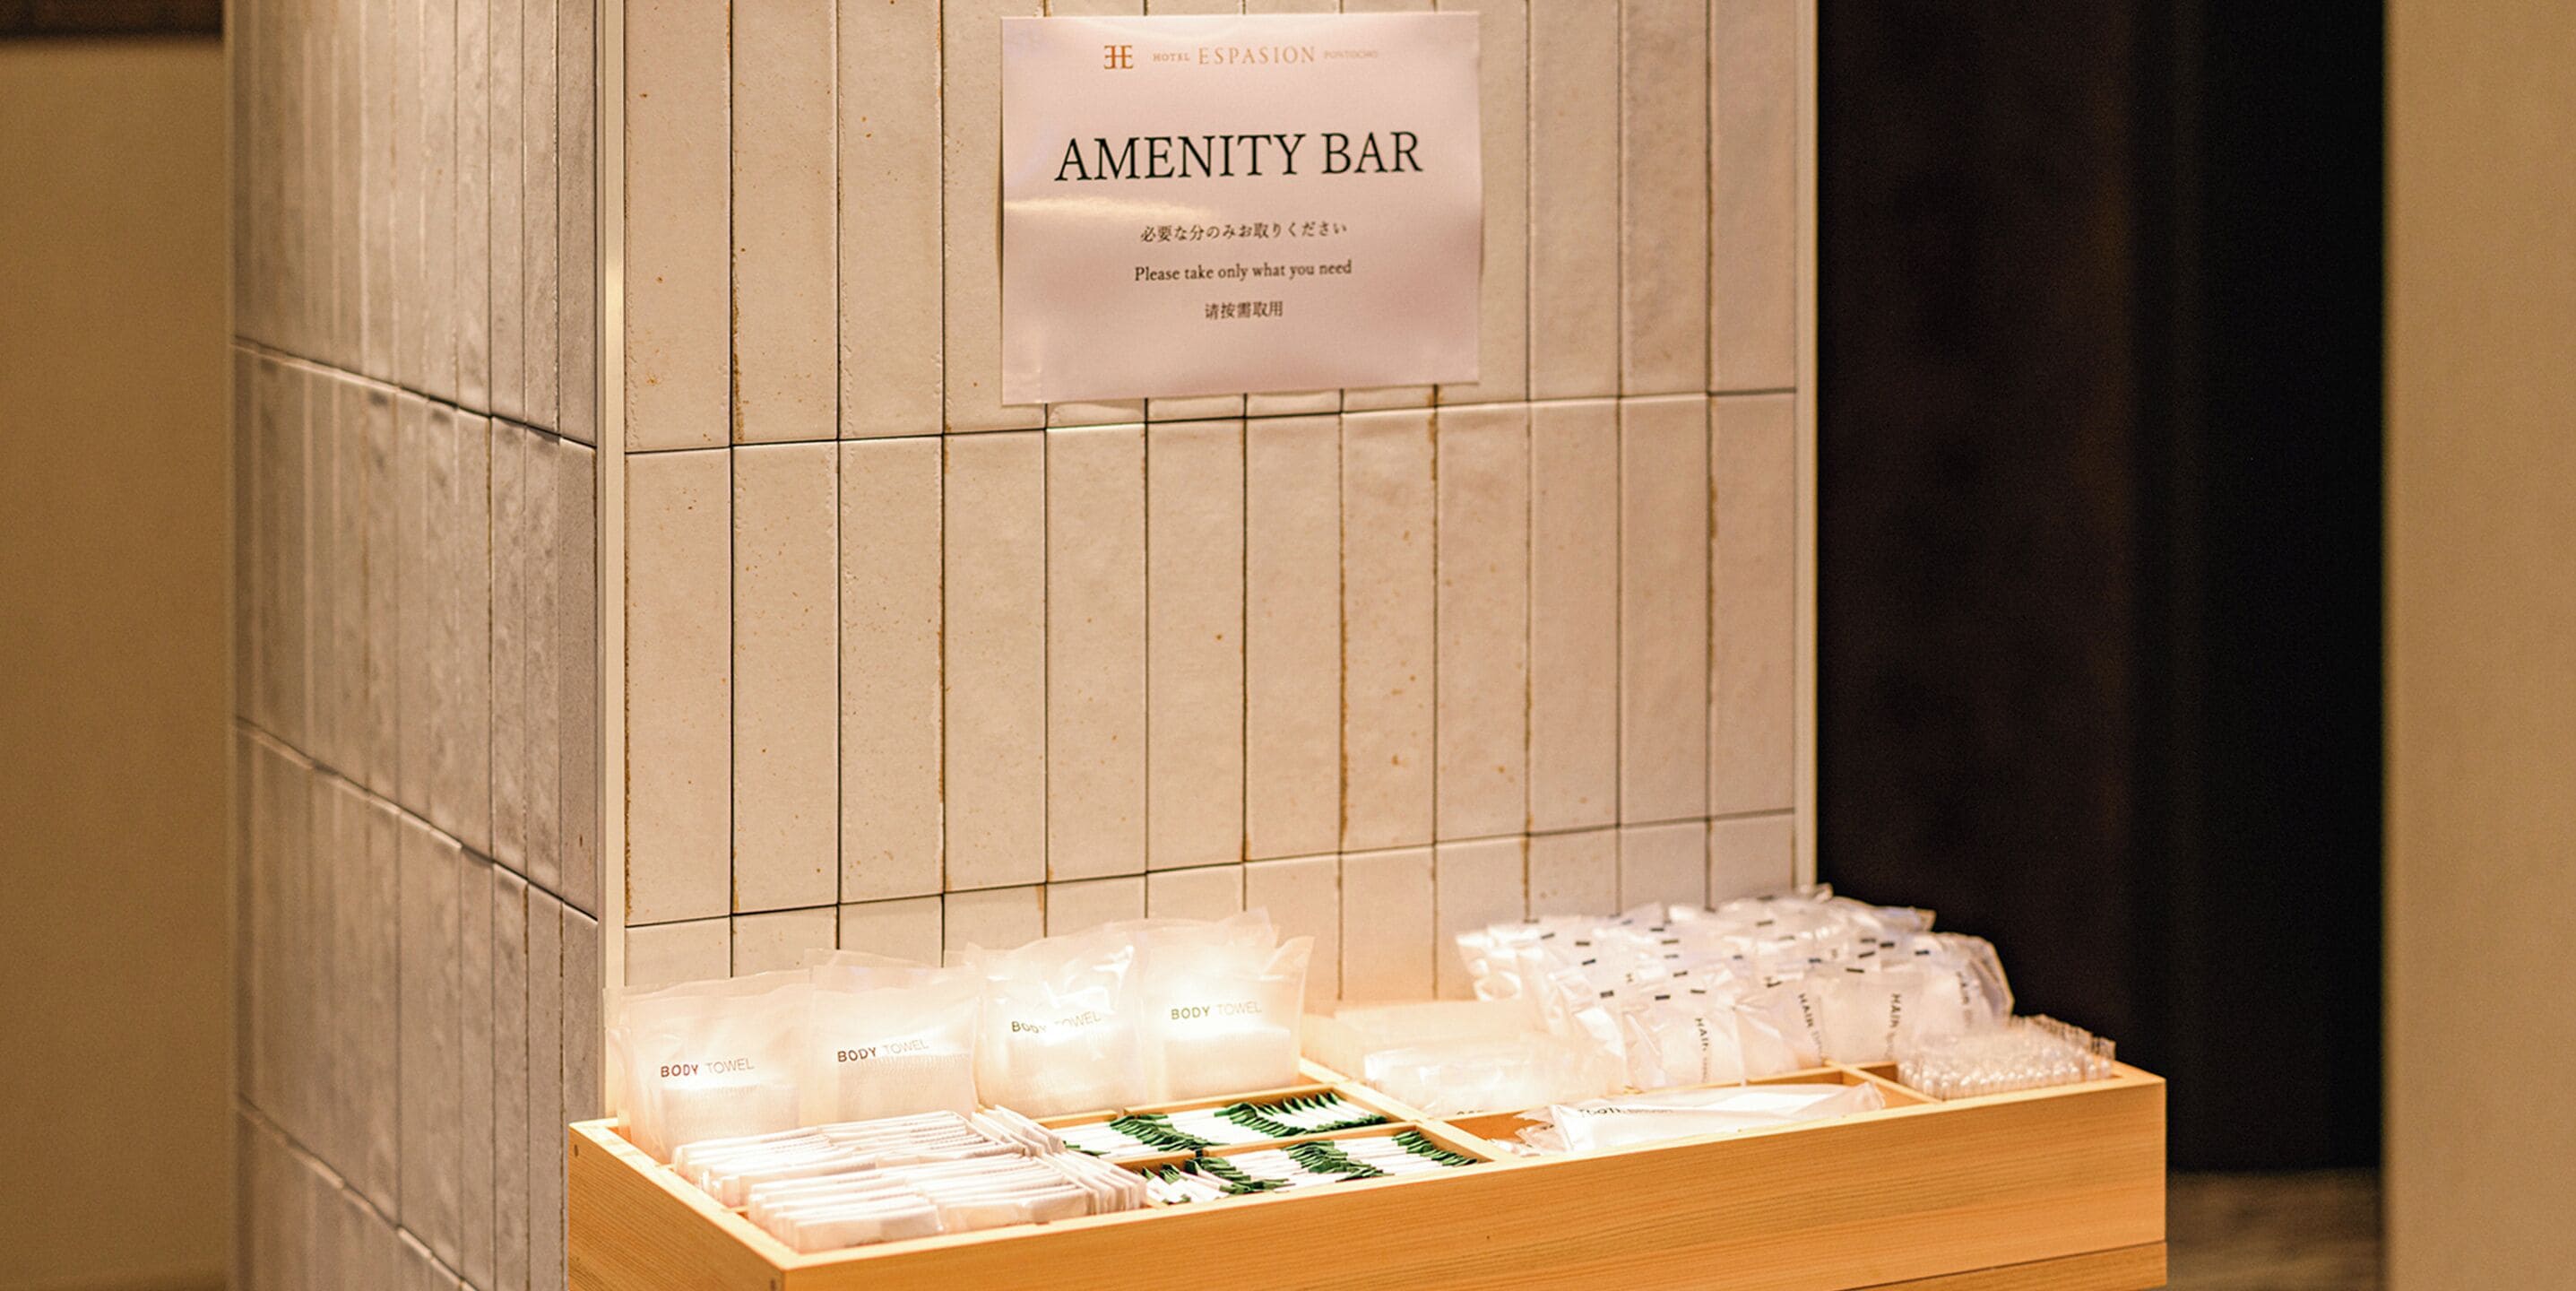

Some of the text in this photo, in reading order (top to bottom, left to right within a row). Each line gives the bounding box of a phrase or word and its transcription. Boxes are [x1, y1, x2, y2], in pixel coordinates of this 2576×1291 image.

[1153, 52, 1190, 62] HOTEL
[1198, 46, 1316, 65] ESPASION
[1054, 131, 1424, 182] AMENITY BAR
[1140, 221, 1348, 243] 必要な分のみお取りください
[1135, 258, 1353, 282] Please take only what you need
[1205, 300, 1284, 320] 请按需取用
[1171, 1000, 1263, 1020] BODY TOWEL
[1799, 992, 1814, 1028] HAIR
[1889, 992, 1902, 1029] HAIR
[837, 1037, 929, 1062] BODY TOWEL
[661, 1057, 755, 1079] BODY TOWEL
